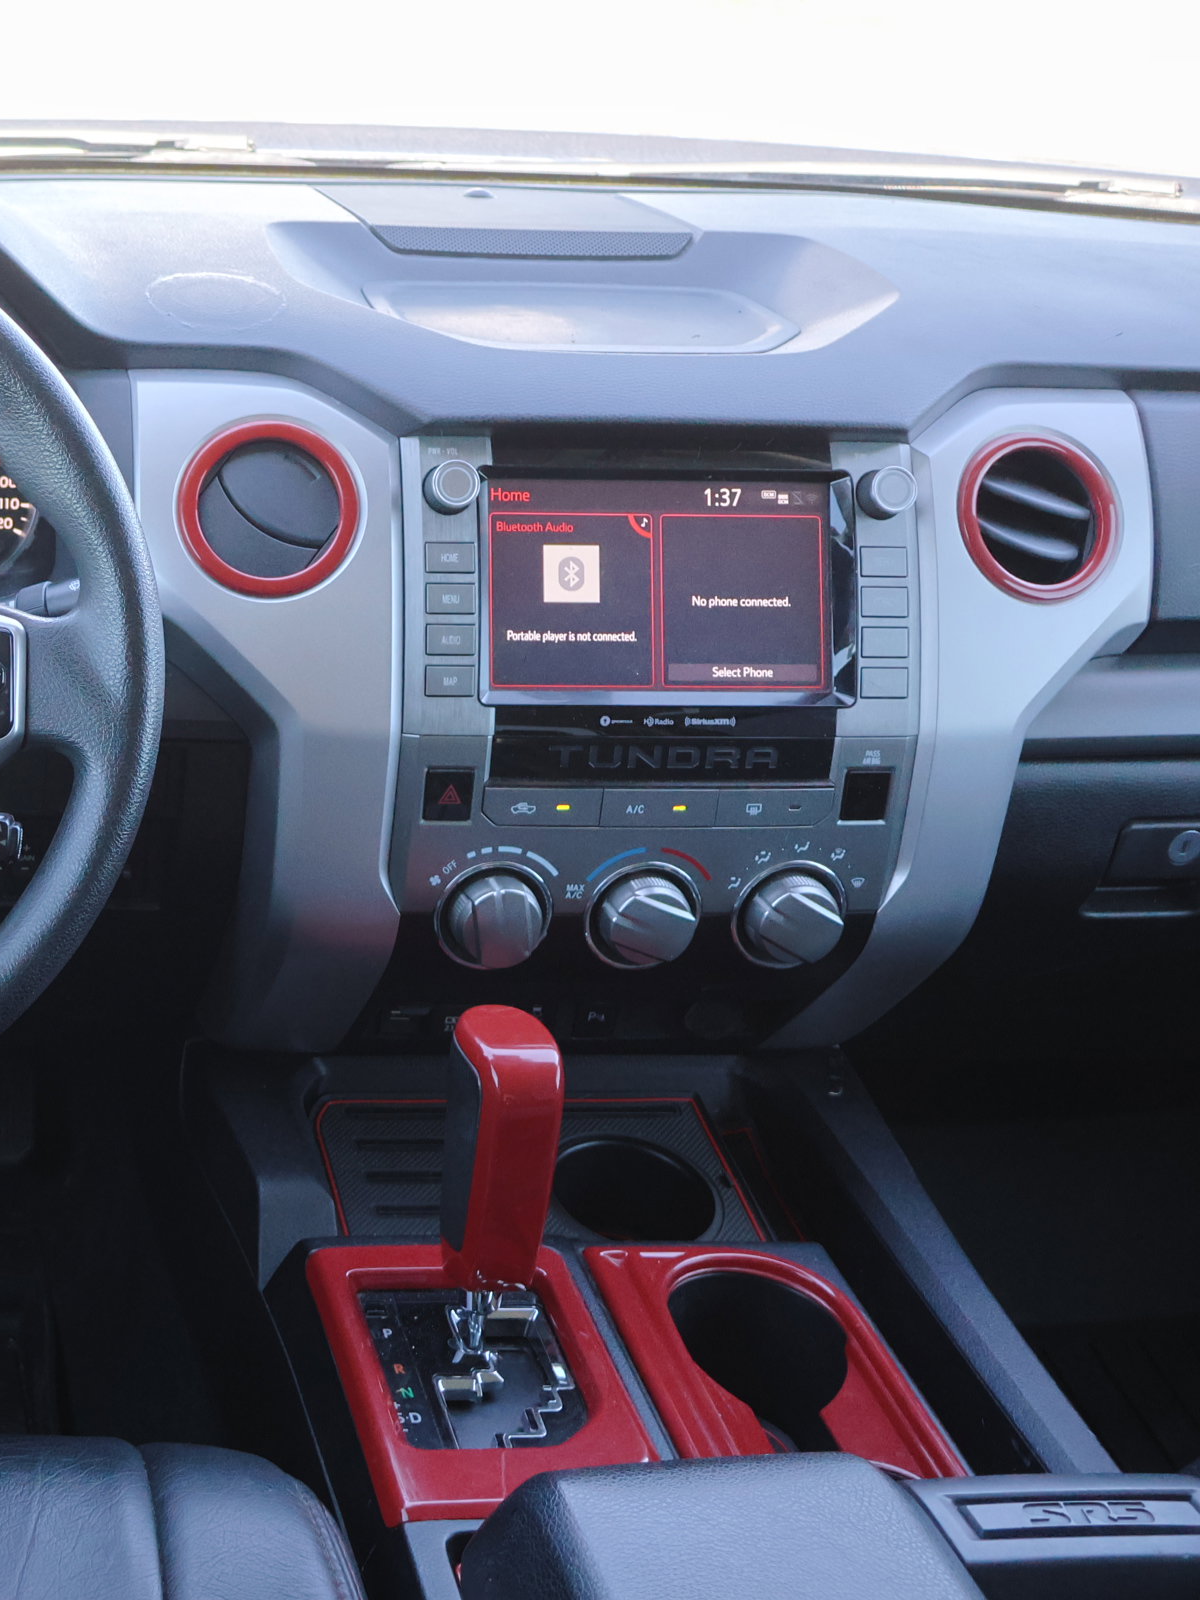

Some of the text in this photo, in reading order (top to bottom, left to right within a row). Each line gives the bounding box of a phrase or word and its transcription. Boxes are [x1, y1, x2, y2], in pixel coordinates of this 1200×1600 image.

[490, 488, 741, 507] Home 1:37
[0, 498, 19, 510] 110
[496, 521, 574, 533] Bluetooth Audio
[440, 553, 459, 564] HOME
[691, 595, 791, 609] No phone connected.
[506, 629, 638, 644] Portable player is not connected.
[712, 666, 773, 679] Select Phone
[655, 718, 674, 726] Radio
[549, 744, 779, 769] TUNDRA
[626, 804, 645, 814] A/C
[442, 859, 457, 875] OFF
[566, 883, 585, 893] MAX
[565, 890, 583, 900] A/C
[382, 1328, 393, 1339] P
[393, 1363, 406, 1375] R
[402, 1386, 414, 1398] N
[1022, 1501, 1155, 1525] SR5
